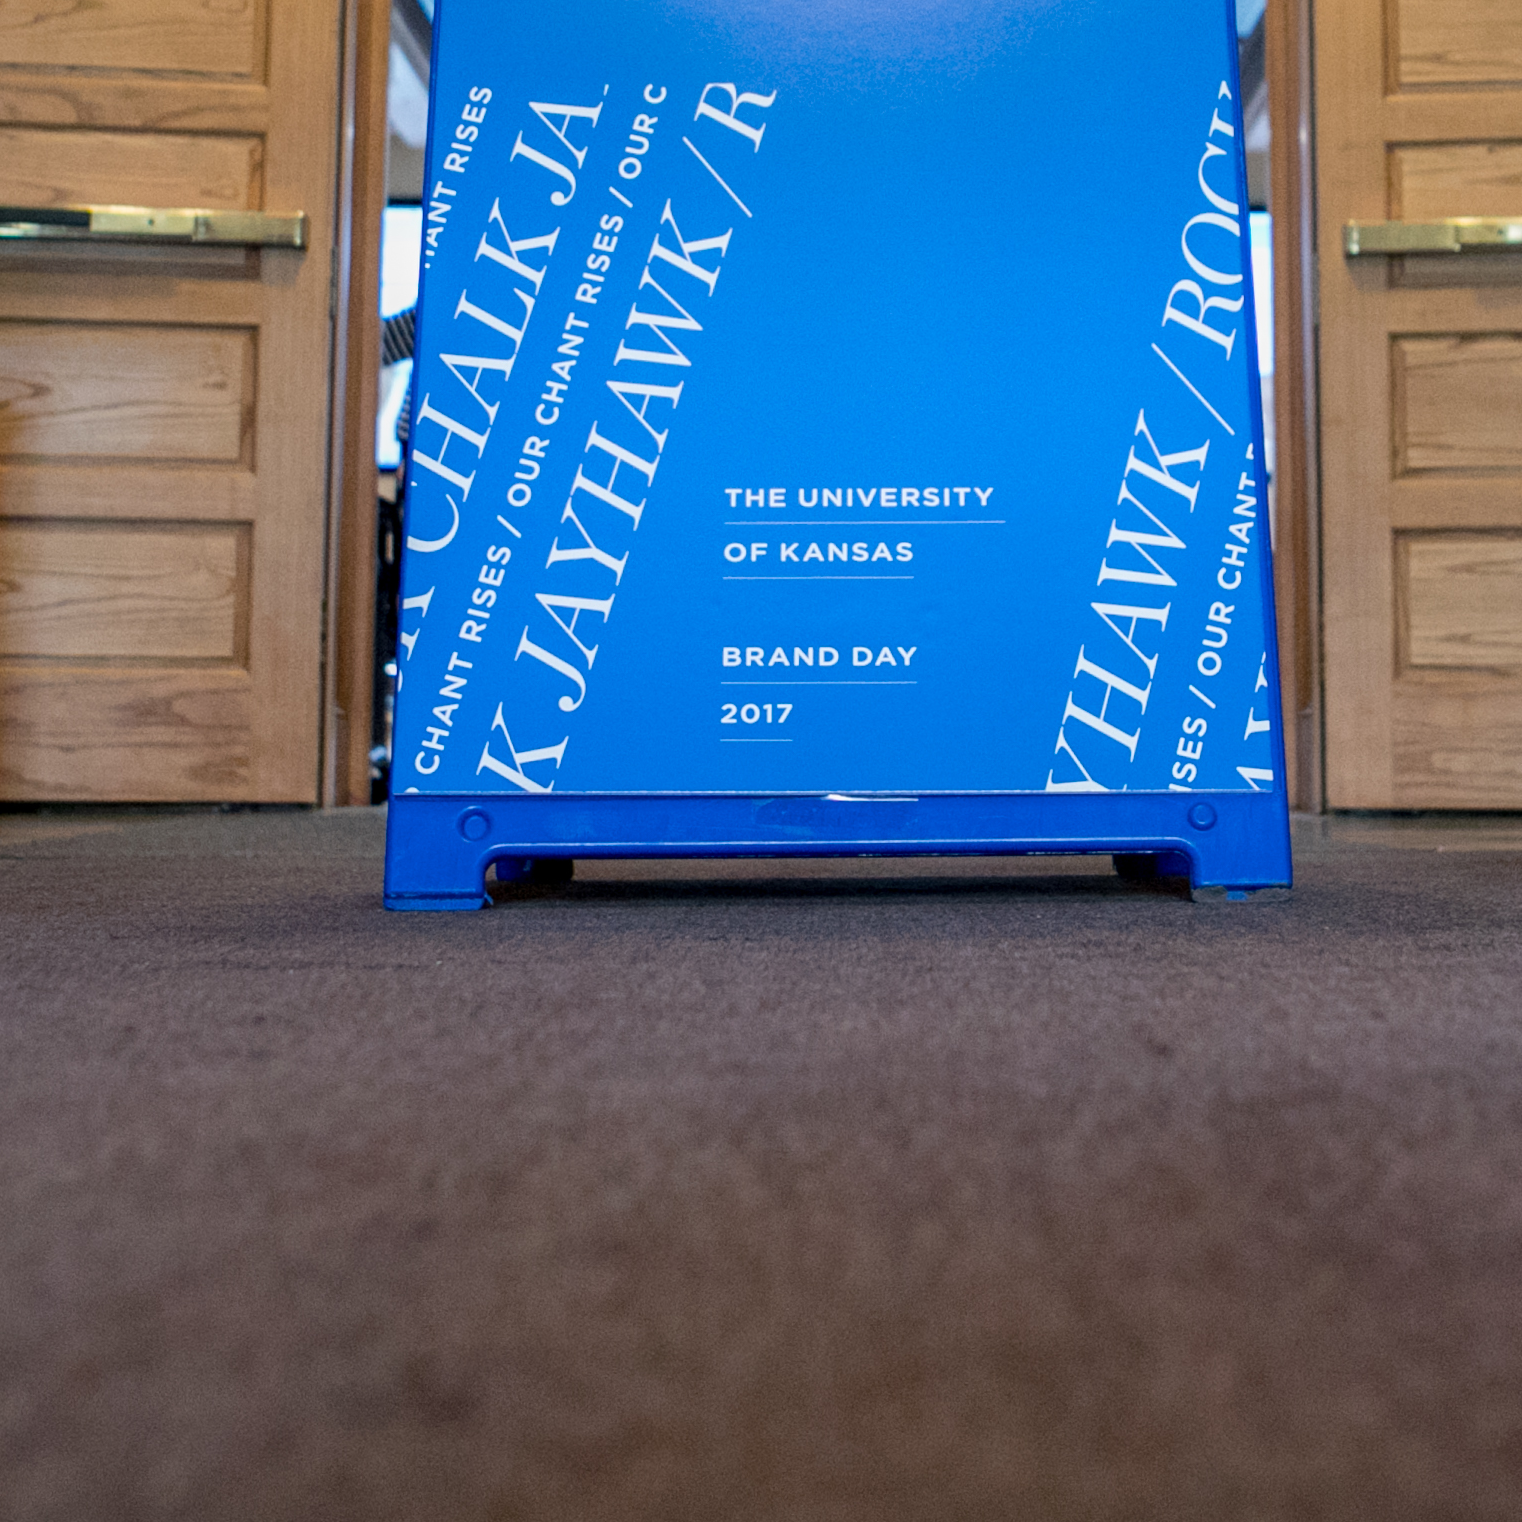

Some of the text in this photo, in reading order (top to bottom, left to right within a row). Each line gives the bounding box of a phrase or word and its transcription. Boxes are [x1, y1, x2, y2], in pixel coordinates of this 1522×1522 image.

[442, 85, 493, 174] RISES
[414, 651, 474, 775] CHANT
[458, 544, 512, 643] RISES
[506, 435, 551, 508] OUR
[534, 311, 590, 426] CHANT
[574, 213, 625, 305] RISES
[617, 113, 659, 180] OUR
[514, 197, 734, 713] JAYHAWK
[724, 486, 995, 509] THE UNIVERSITY
[723, 541, 915, 563] OF KANSAS
[1196, 600, 1236, 677] OUR
[1216, 471, 1257, 591] CHANT
[721, 646, 918, 668] BRAND DAY
[720, 703, 794, 725] 2017
